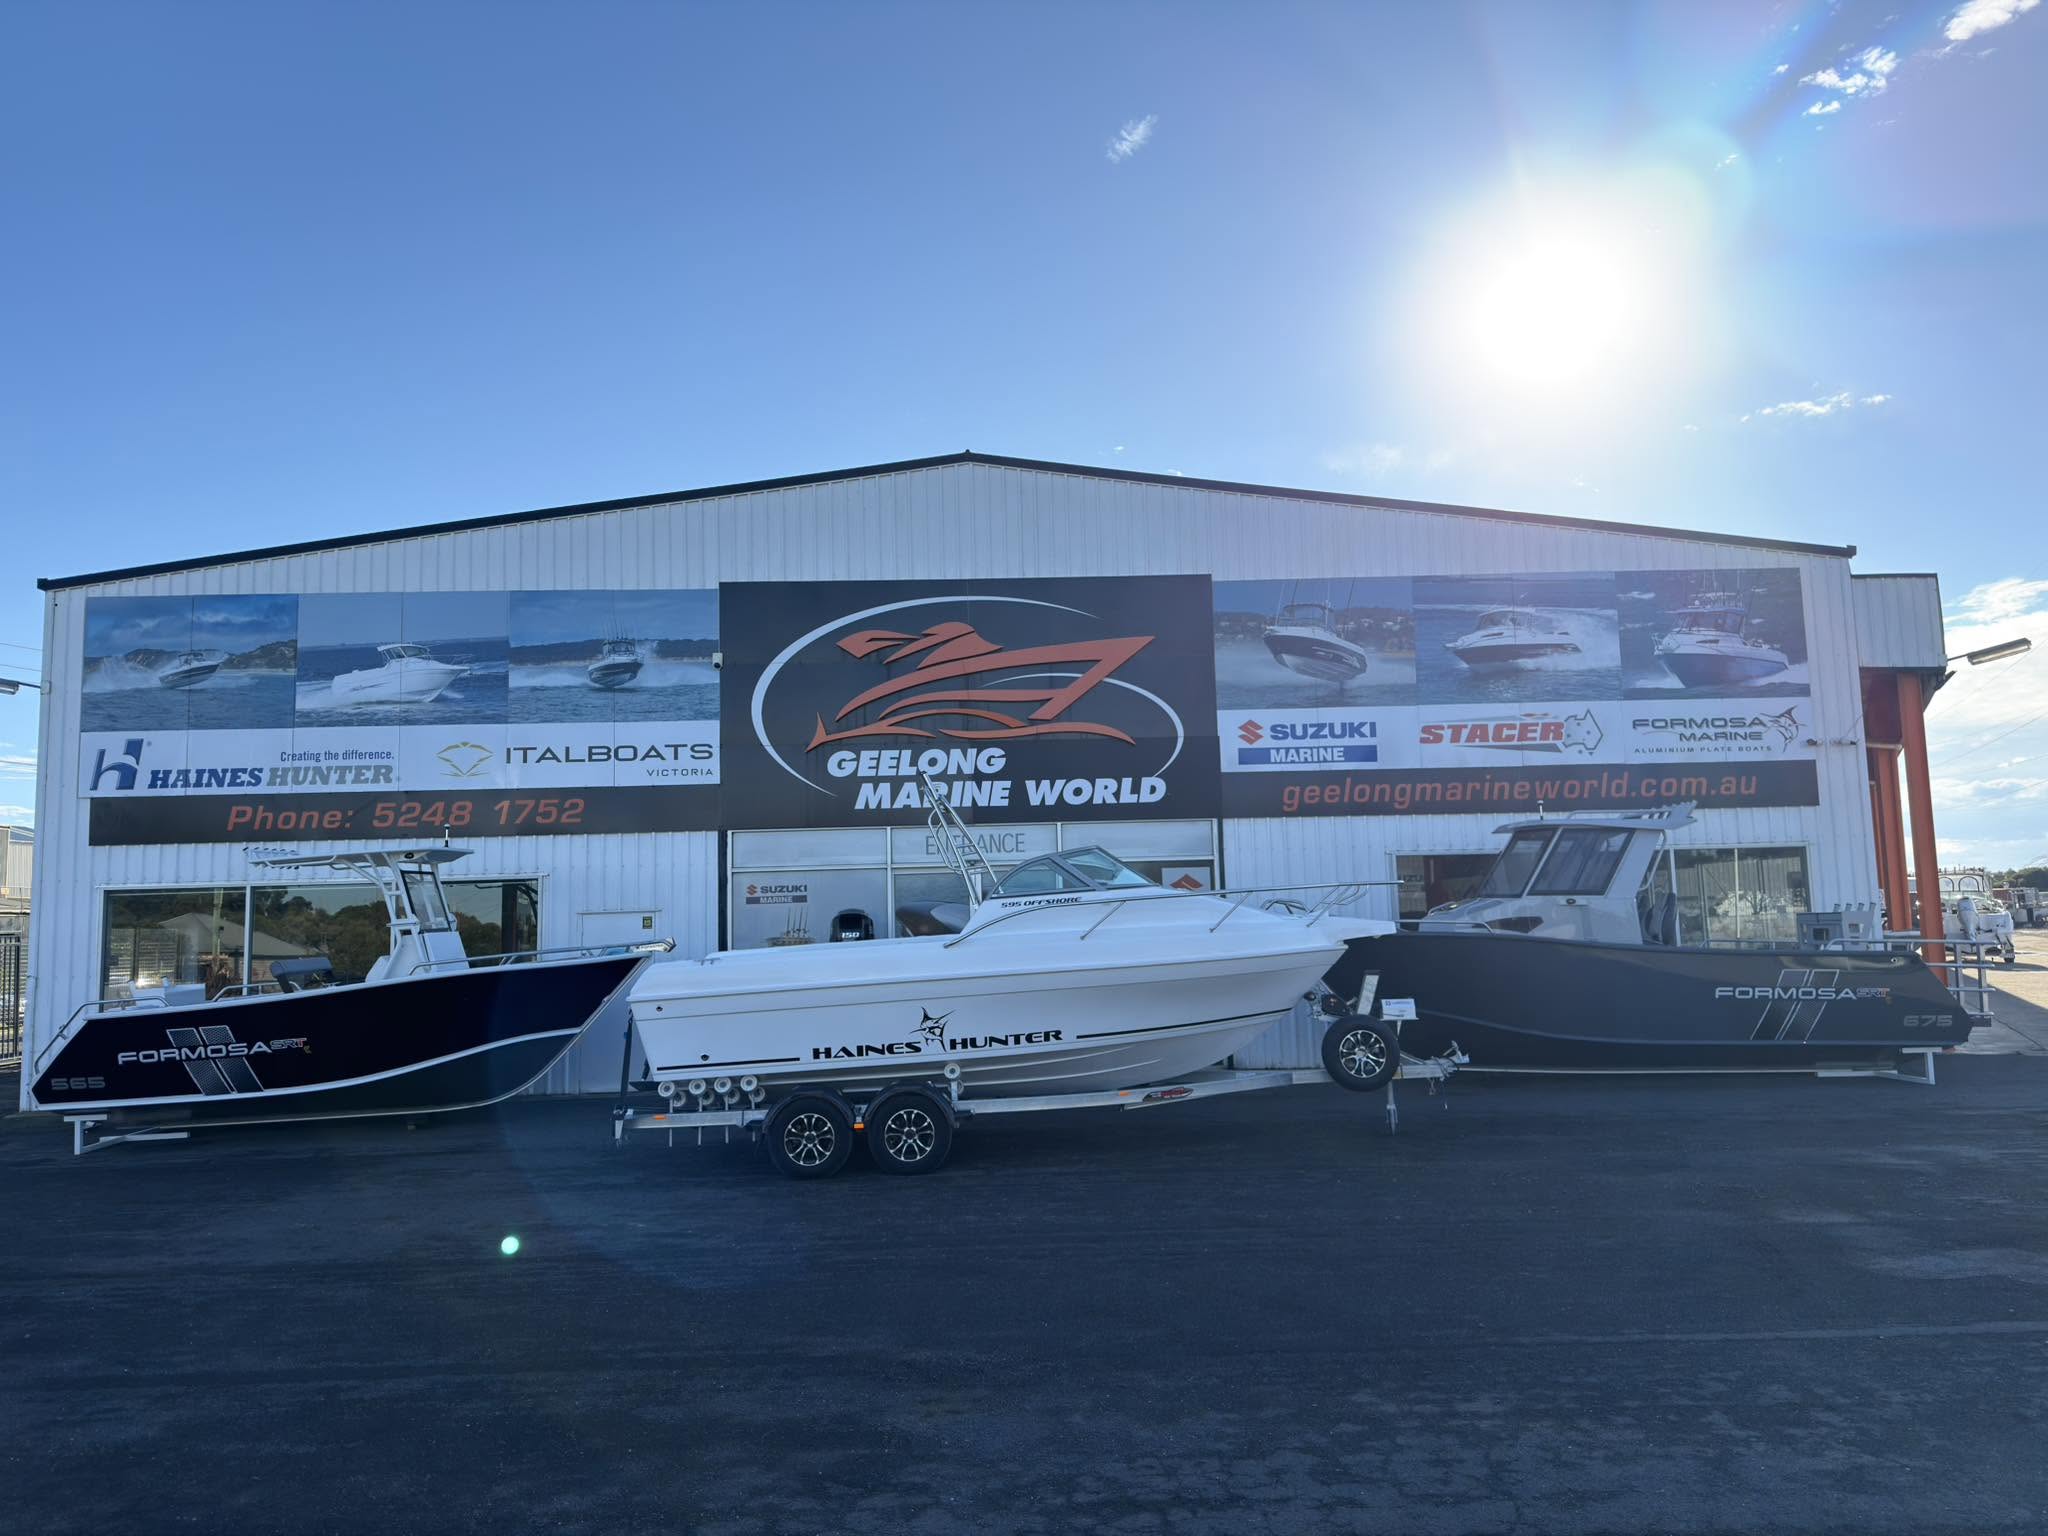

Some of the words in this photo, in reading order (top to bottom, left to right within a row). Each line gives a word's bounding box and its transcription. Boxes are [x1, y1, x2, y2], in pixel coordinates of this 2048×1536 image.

[1270, 722, 1377, 740] SUZUKI
[1632, 718, 1768, 730] FORMOSA
[1419, 722, 1565, 744] STACER
[1679, 731, 1763, 742] MARINE
[280, 751, 321, 763] Creating
[324, 750, 339, 760] the
[342, 749, 395, 761] difference.
[505, 744, 714, 764] ITALBOATS
[1270, 747, 1345, 763] MARINE
[827, 747, 1007, 778] GEELONG
[147, 767, 264, 789] HAINES
[266, 765, 394, 787] HUNTER
[646, 768, 713, 777] VICTORIA
[854, 780, 1012, 810] MARINE
[1025, 776, 1167, 807] WORLD
[1282, 771, 1757, 812] geelongmarineworld.com.au
[226, 804, 354, 832] Phone:
[372, 800, 473, 829] 5248
[494, 798, 585, 825] 1752
[760, 884, 808, 894] SUZUKI
[759, 896, 793, 904] MARINE
[1023, 897, 1081, 907] OFFSHORE
[841, 931, 860, 939] 150
[1714, 987, 1857, 1000] FORMOSA
[1856, 987, 1890, 998] SRT
[1903, 1015, 1953, 1027] 675
[117, 1041, 272, 1065] FORMOSA
[270, 1038, 307, 1050] SRT
[812, 1041, 922, 1060] HAINES
[950, 1029, 1063, 1051] HUNTER
[51, 1077, 106, 1091] 565
